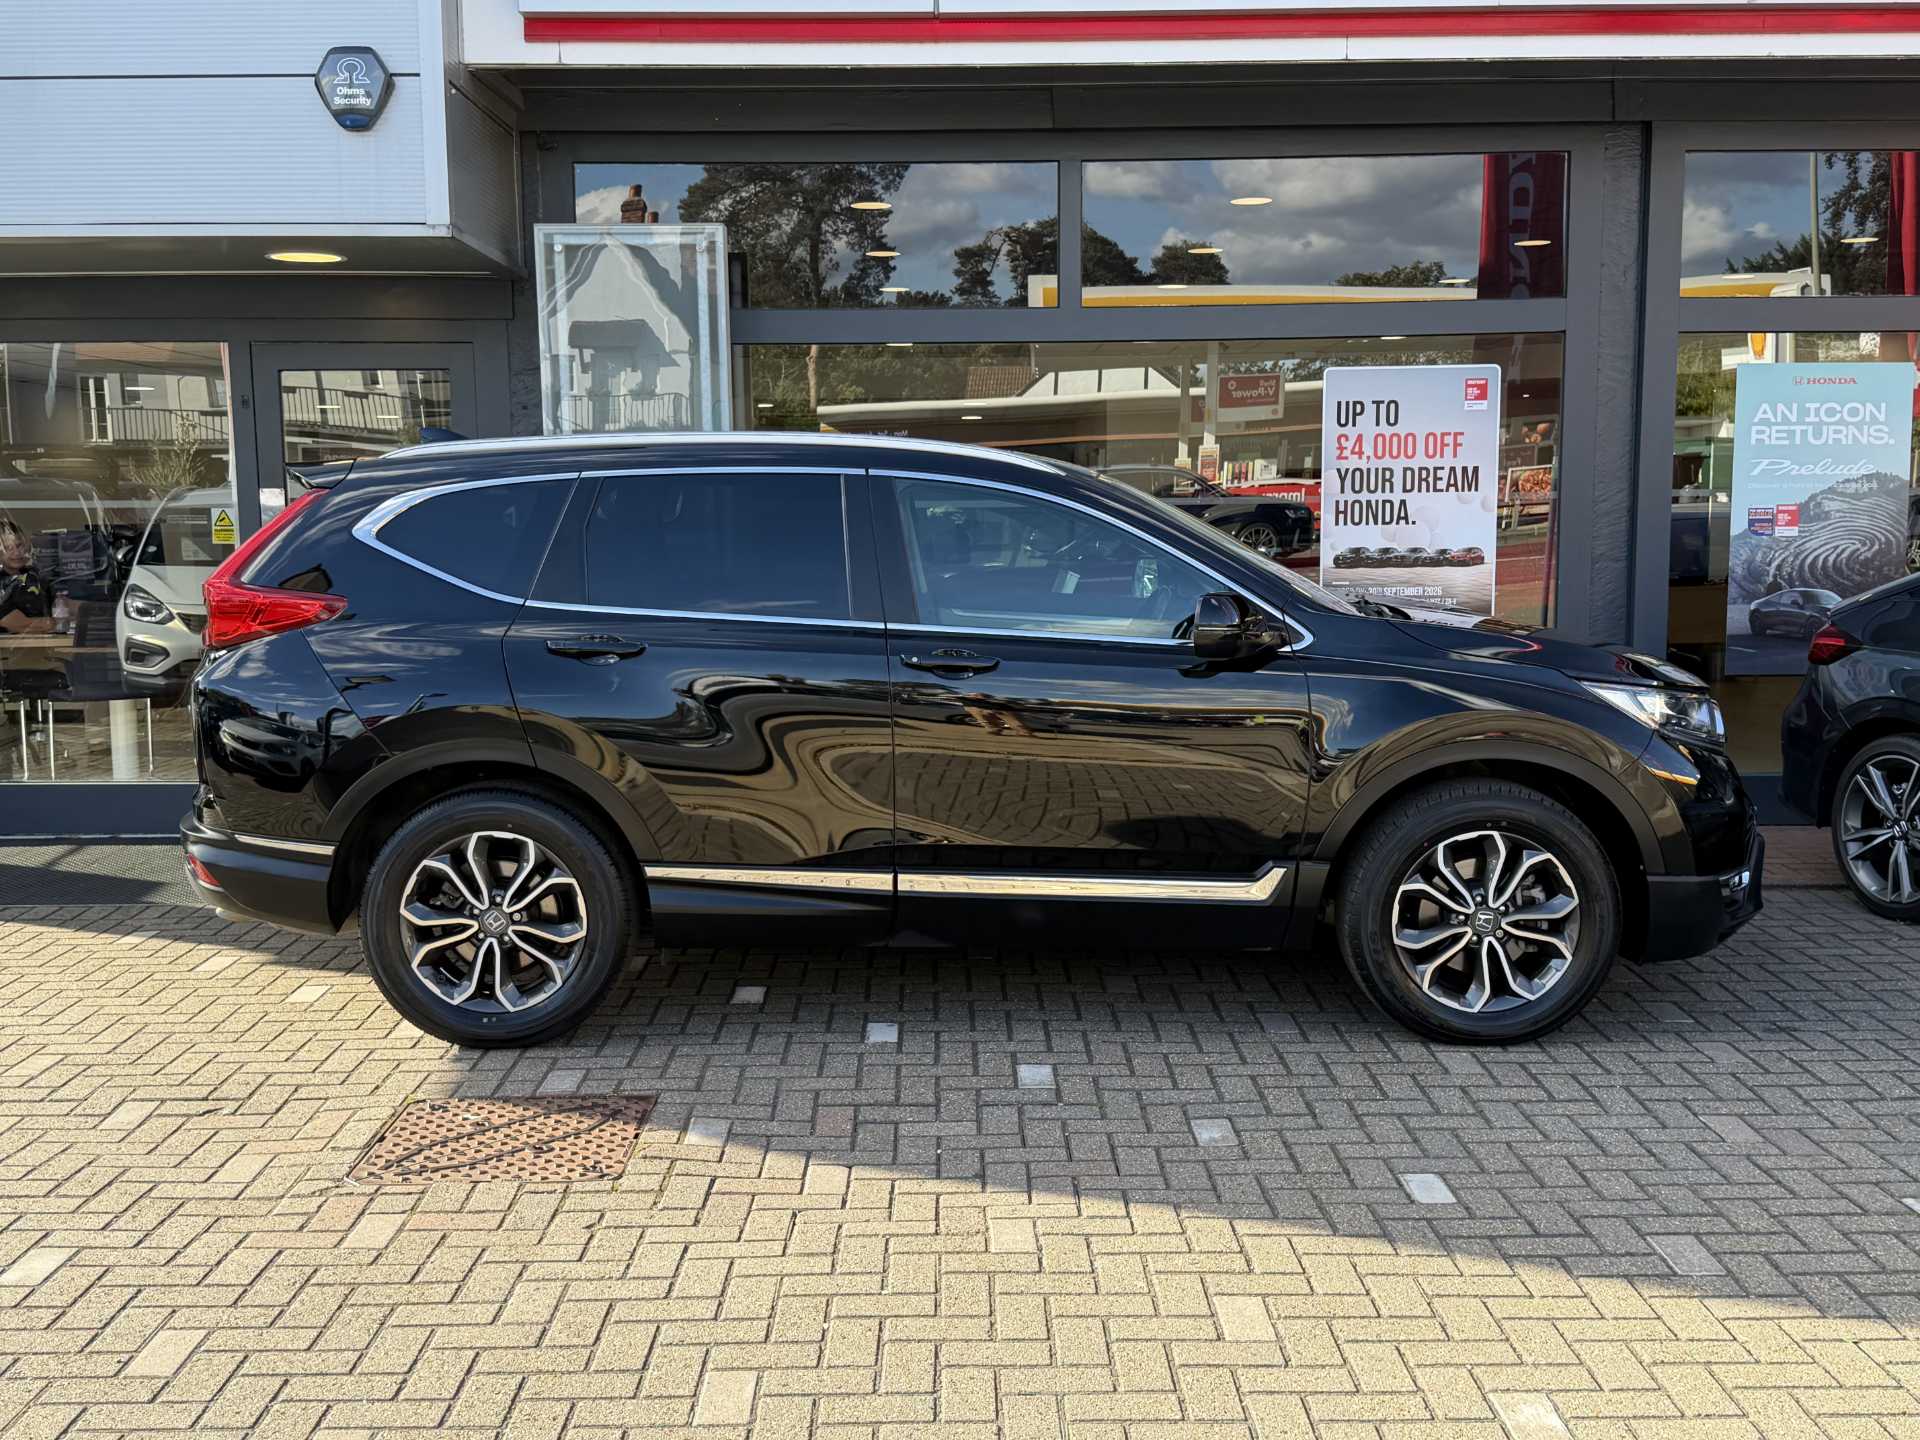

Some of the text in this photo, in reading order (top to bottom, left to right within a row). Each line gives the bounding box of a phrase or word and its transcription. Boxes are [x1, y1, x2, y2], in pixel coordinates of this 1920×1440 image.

[333, 96, 372, 106] Security
[336, 86, 365, 95] Ohms
[1806, 377, 1858, 385] HONDA
[1336, 400, 1399, 428] UP TO
[1753, 401, 1886, 423] AN ICON
[1750, 424, 1896, 446] RETURNS.
[1336, 431, 1465, 464] £4,000 OFF
[1750, 458, 1877, 477] Prelude
[1336, 466, 1480, 494] YOUR DREAM
[1335, 499, 1417, 526] HONDA.
[1383, 586, 1423, 596] SEPTEMBER
